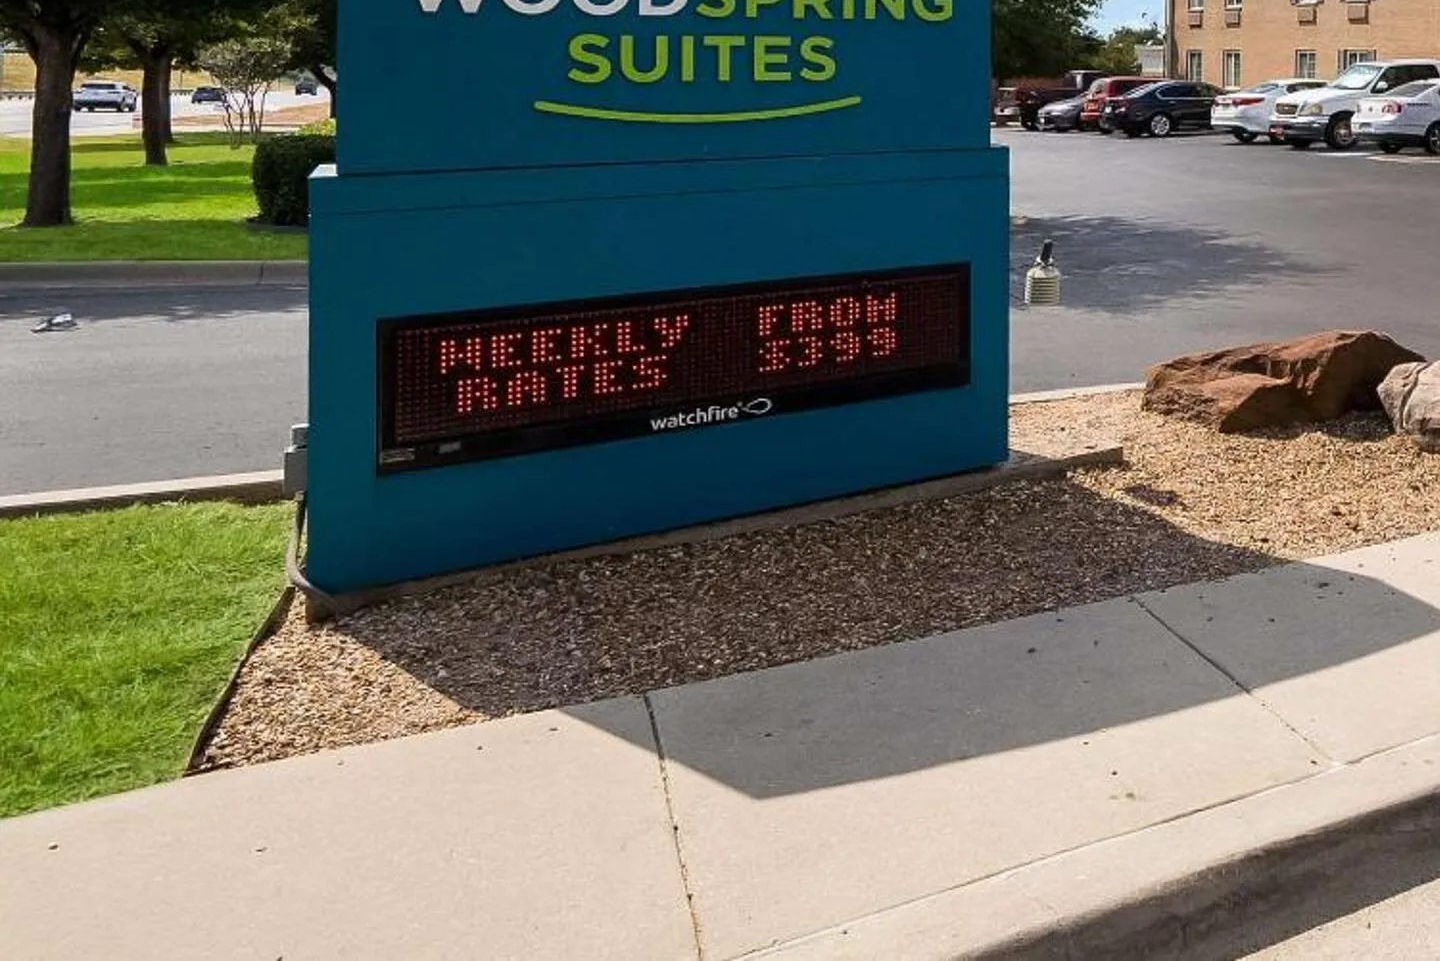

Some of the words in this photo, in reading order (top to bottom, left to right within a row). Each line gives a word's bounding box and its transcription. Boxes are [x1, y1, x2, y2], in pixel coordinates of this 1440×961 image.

[568, 35, 836, 83] SUITES
[440, 314, 689, 374] WEEKLY
[758, 292, 898, 336] FROM
[457, 355, 668, 413] RATES
[758, 327, 898, 372] $399
